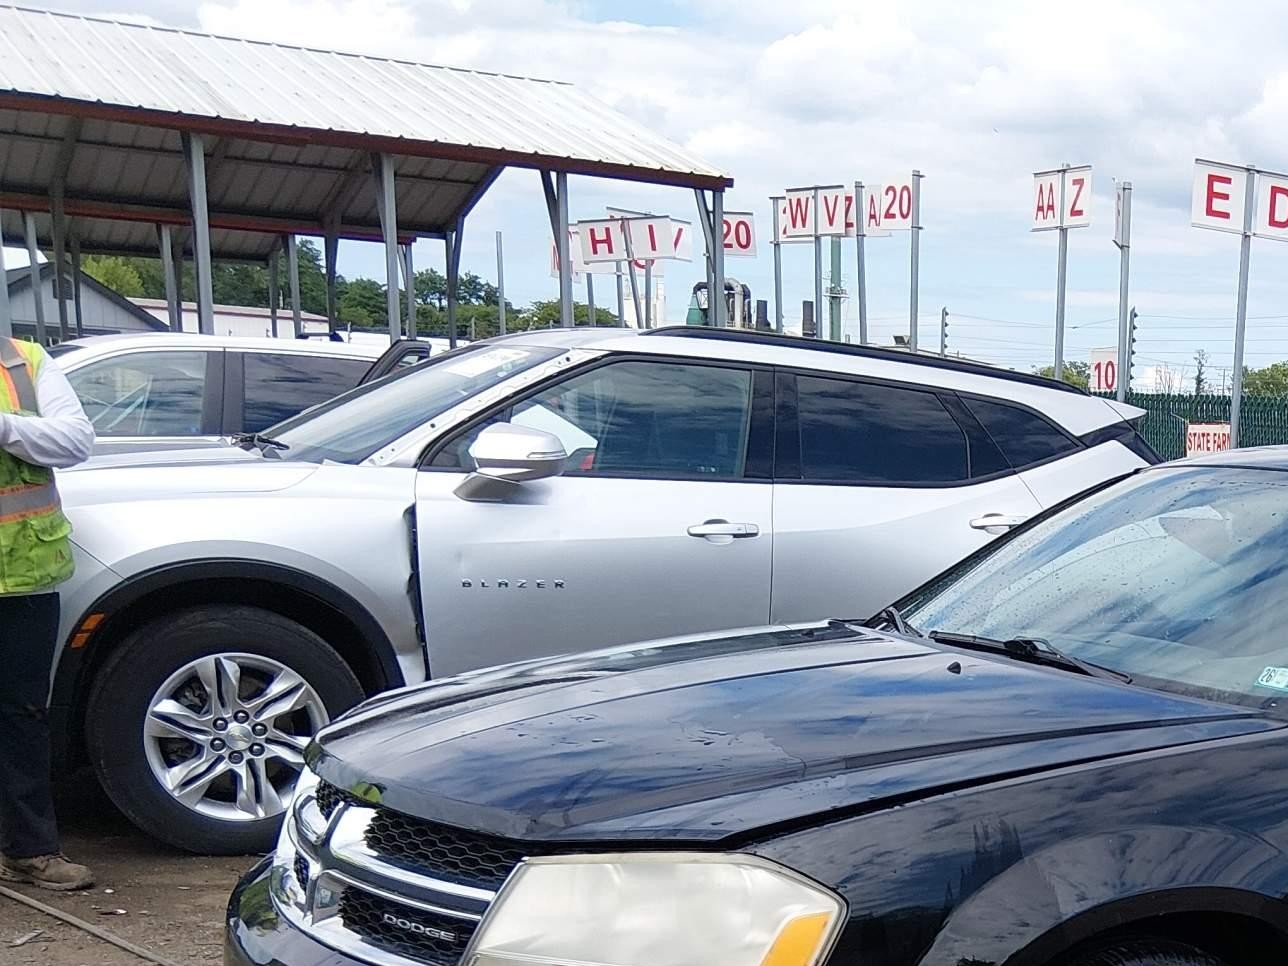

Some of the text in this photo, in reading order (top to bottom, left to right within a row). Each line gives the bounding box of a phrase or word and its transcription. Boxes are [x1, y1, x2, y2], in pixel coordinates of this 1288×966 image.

[823, 194, 839, 227] V
[883, 184, 912, 220] 20
[1035, 183, 1056, 221] AA
[1069, 178, 1085, 217] Z
[1204, 173, 1233, 220] E
[788, 196, 810, 229] W
[589, 226, 614, 255] H
[647, 224, 657, 252] I
[1093, 360, 1116, 390] 10
[1186, 431, 1211, 452] STATE
[461, 578, 566, 589] BLAZER
[383, 913, 456, 942] DODGE
